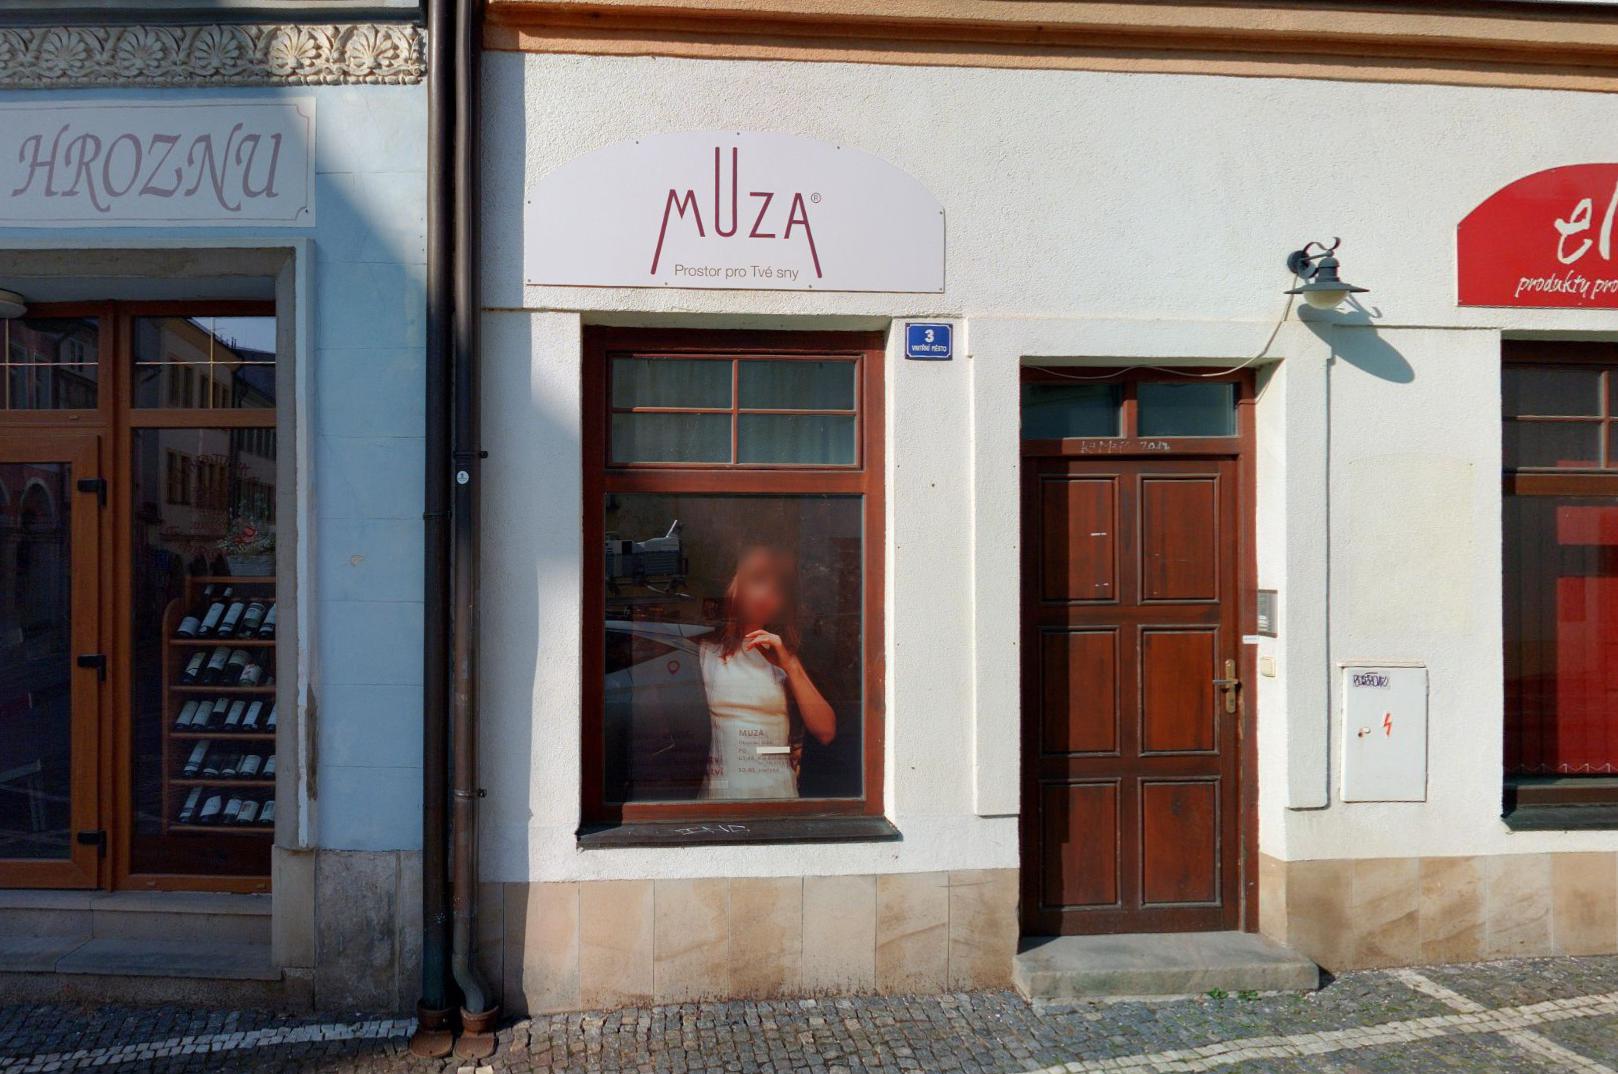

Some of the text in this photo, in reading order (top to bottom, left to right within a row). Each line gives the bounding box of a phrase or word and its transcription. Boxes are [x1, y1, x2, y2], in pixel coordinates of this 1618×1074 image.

[11, 122, 283, 212] HROZNU
[674, 264, 799, 280] Prostor pro Tvé sny
[1514, 269, 1590, 298] produkty
[924, 329, 935, 343] 3
